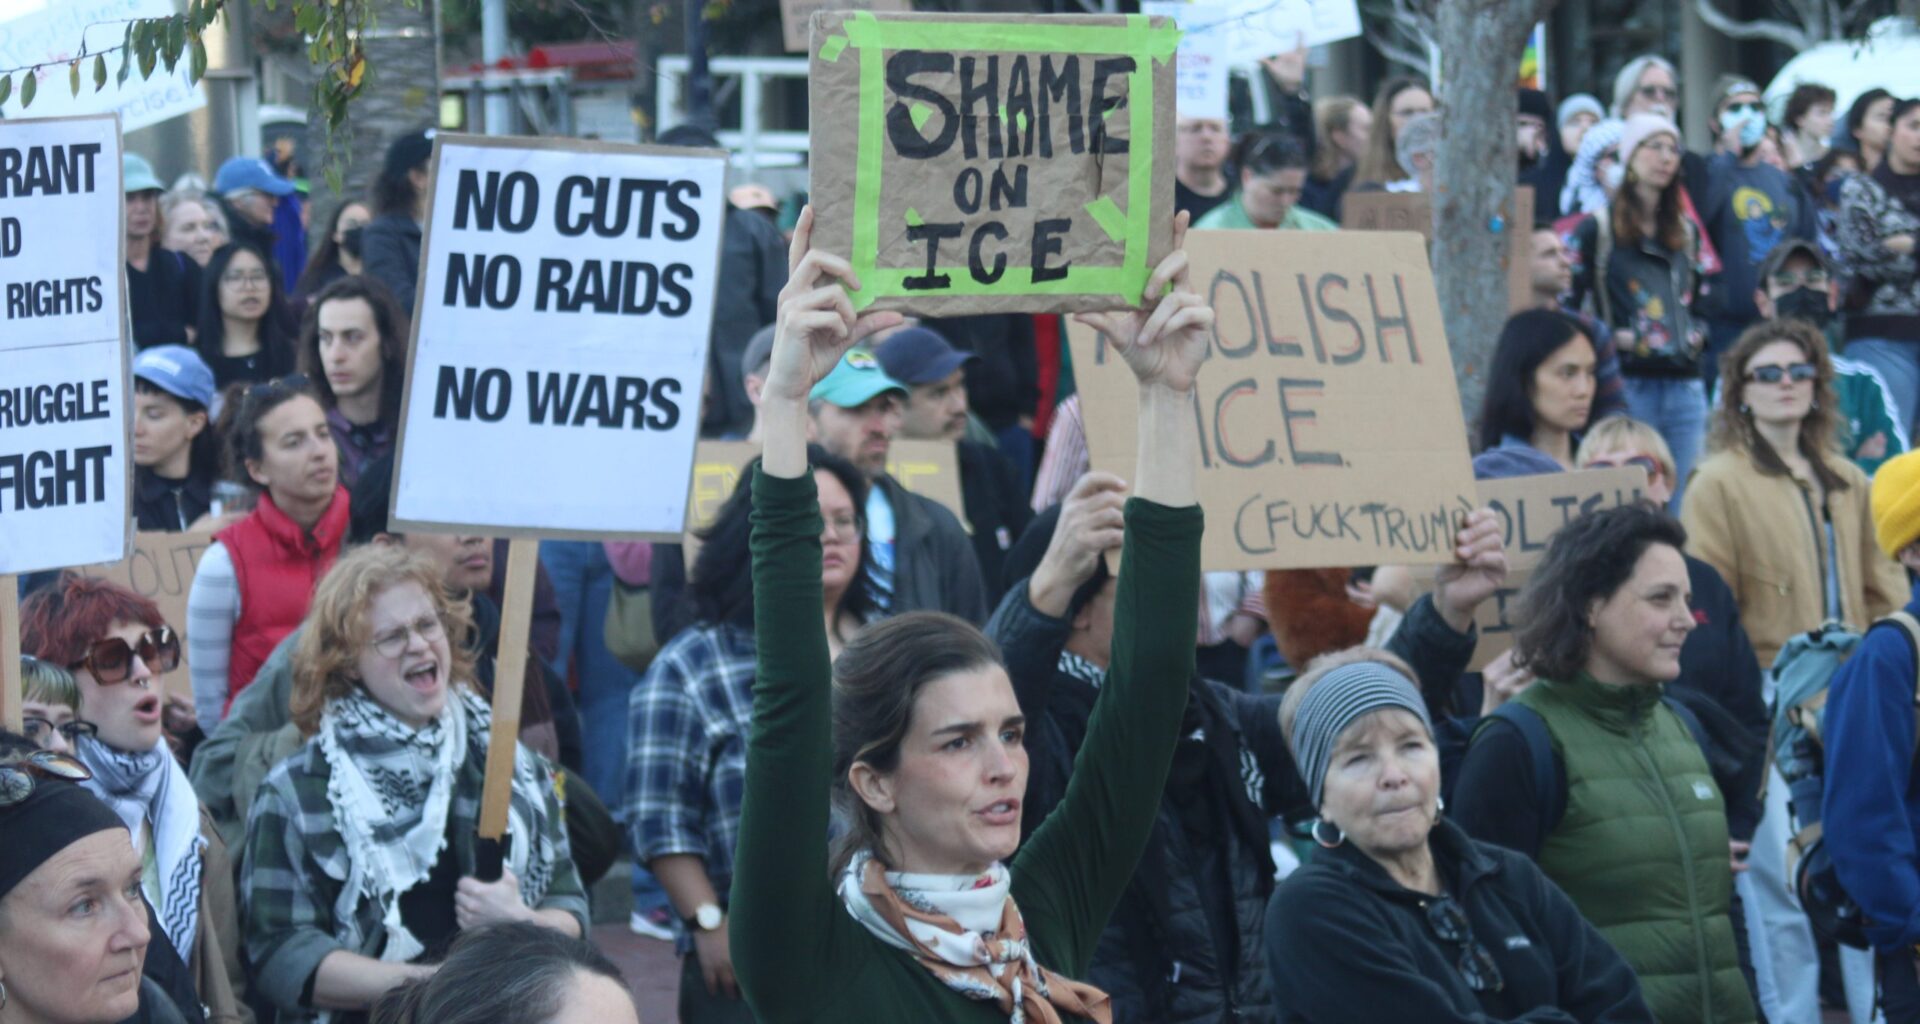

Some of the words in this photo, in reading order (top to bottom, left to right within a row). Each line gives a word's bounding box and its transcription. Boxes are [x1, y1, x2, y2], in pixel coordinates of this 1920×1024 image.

[885, 49, 1137, 159] SHAME
[452, 169, 540, 233] NO
[554, 175, 701, 241] CUTS
[953, 164, 1028, 215] ON
[0, 217, 22, 258] D
[902, 218, 1072, 290] ICE
[6, 275, 103, 320] RIGHTS
[443, 253, 522, 310] NO
[534, 258, 694, 318] RAIDS
[1095, 268, 1423, 367] OLISH
[433, 365, 512, 422] NO
[526, 370, 682, 431] WARS
